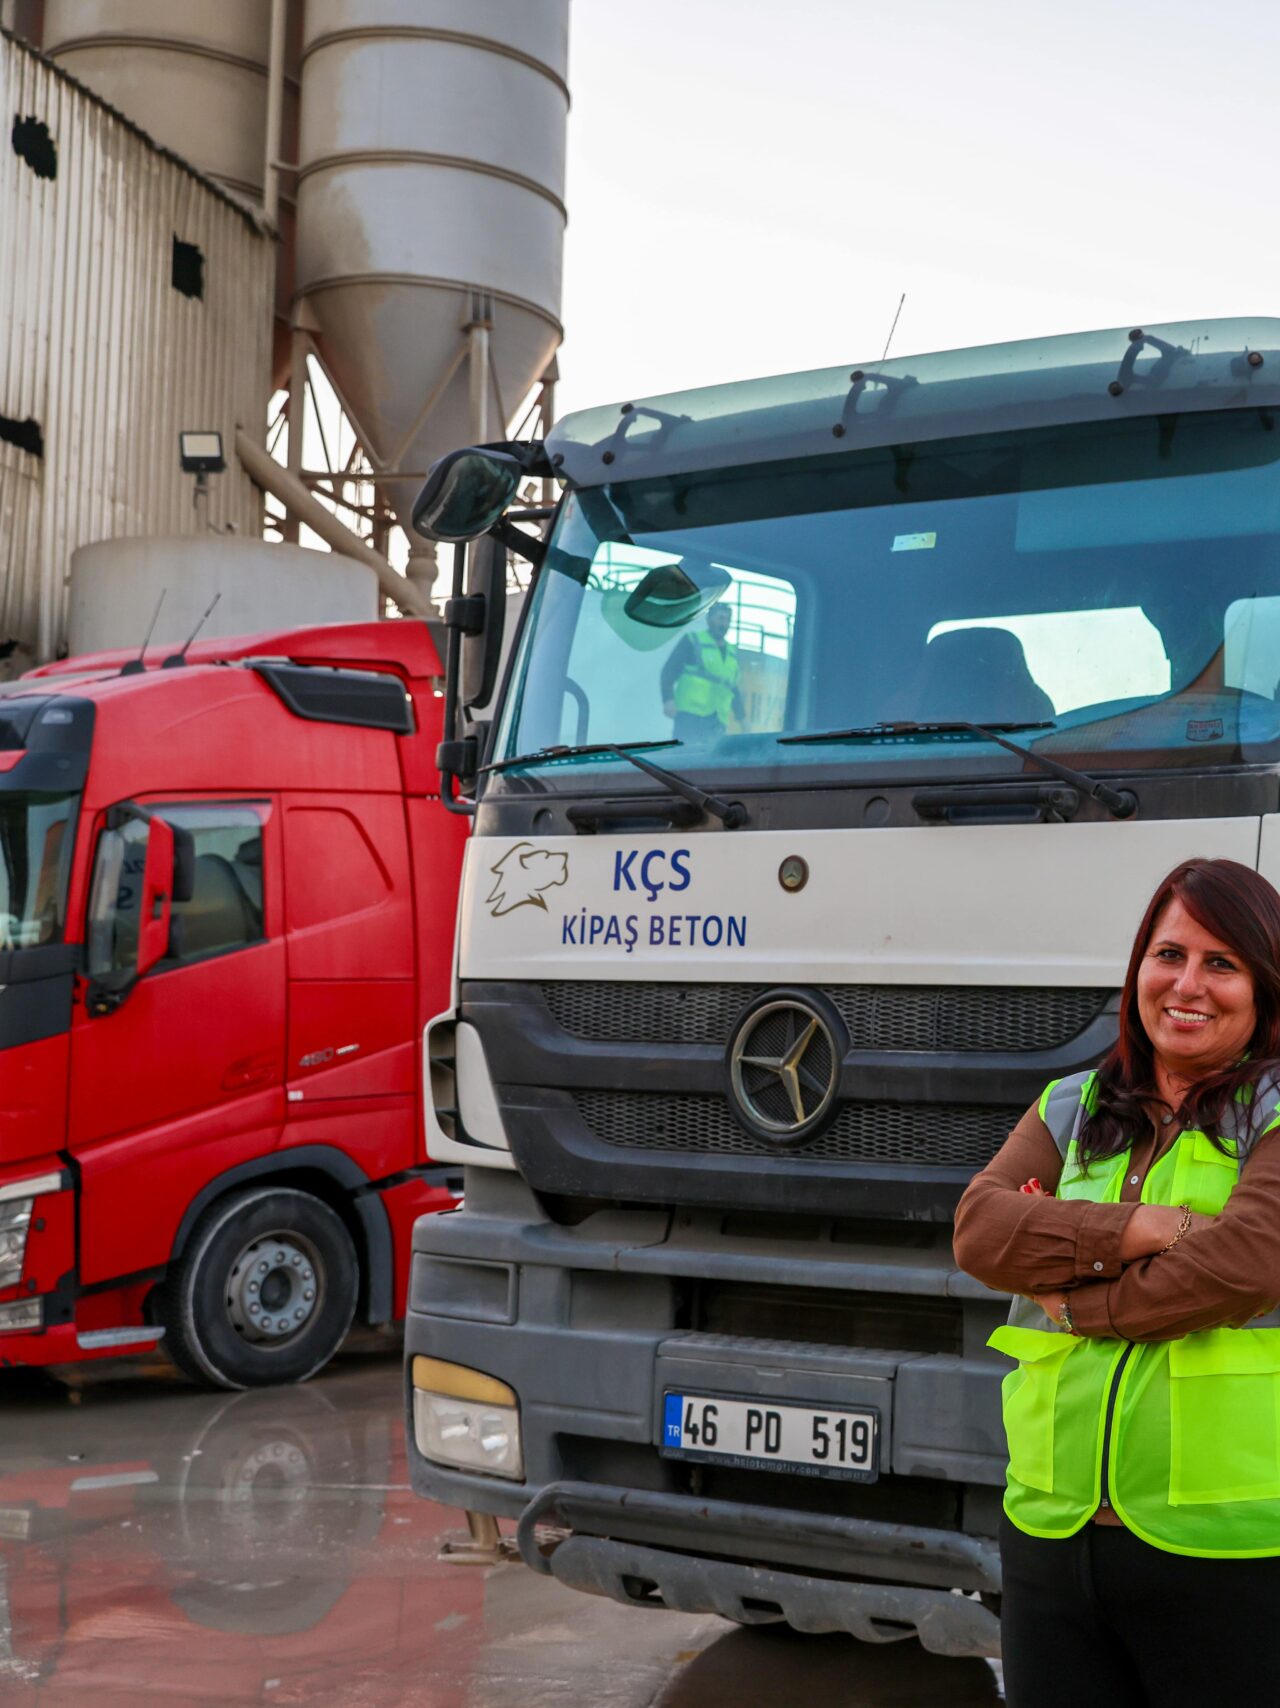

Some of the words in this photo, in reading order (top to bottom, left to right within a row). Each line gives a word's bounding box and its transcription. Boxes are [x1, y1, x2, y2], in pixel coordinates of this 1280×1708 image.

[612, 849, 692, 902] KÇS
[562, 907, 639, 952] KİPAŞ
[649, 914, 747, 947] BETON
[668, 1424, 681, 1438] TR
[683, 1402, 719, 1447] 46
[745, 1408, 782, 1454] PD
[812, 1415, 869, 1464] 519
